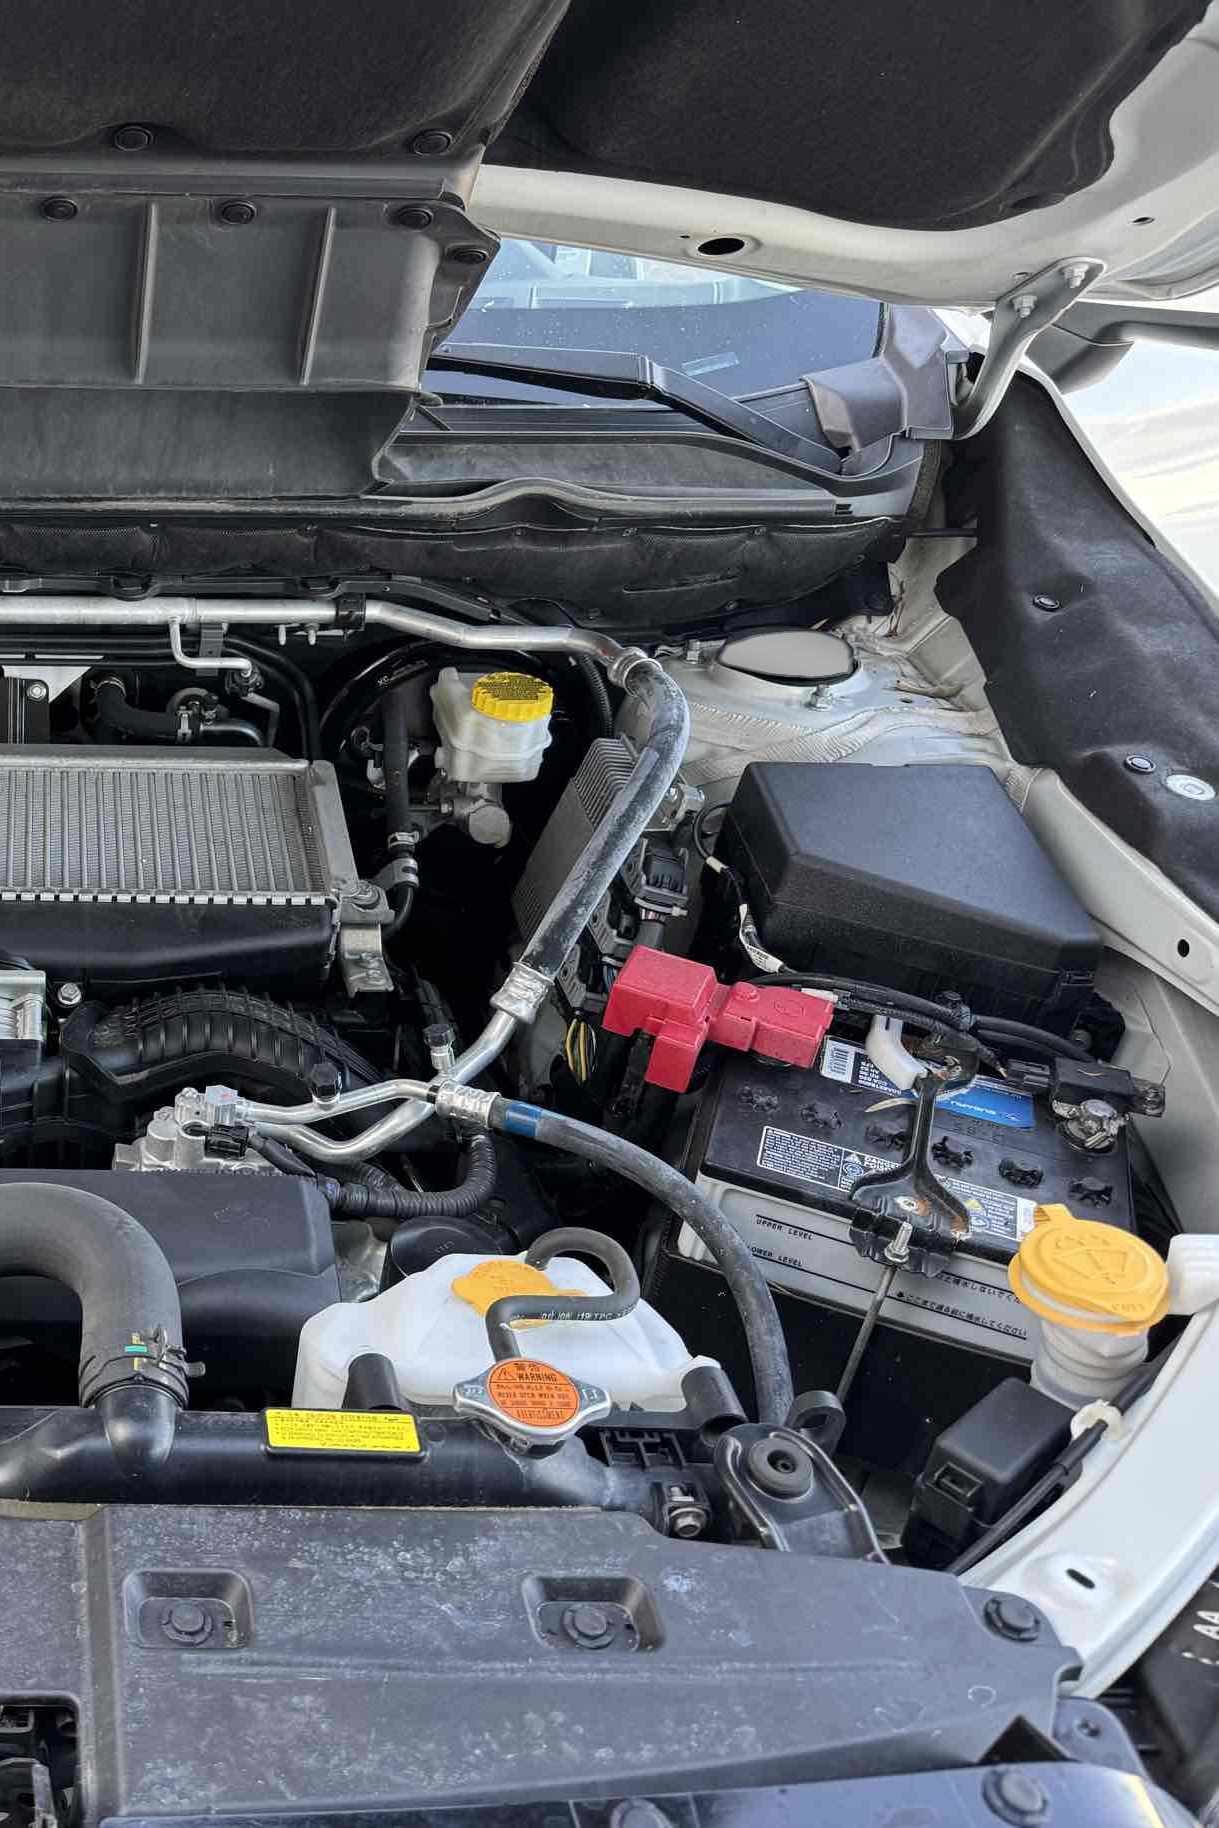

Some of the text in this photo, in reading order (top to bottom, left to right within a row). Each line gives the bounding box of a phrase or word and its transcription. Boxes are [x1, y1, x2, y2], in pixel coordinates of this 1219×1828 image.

[756, 1218, 813, 1240] UPPER LEVEL
[750, 1246, 802, 1267] OWER LEVEL
[517, 1372, 558, 1382] WARNING
